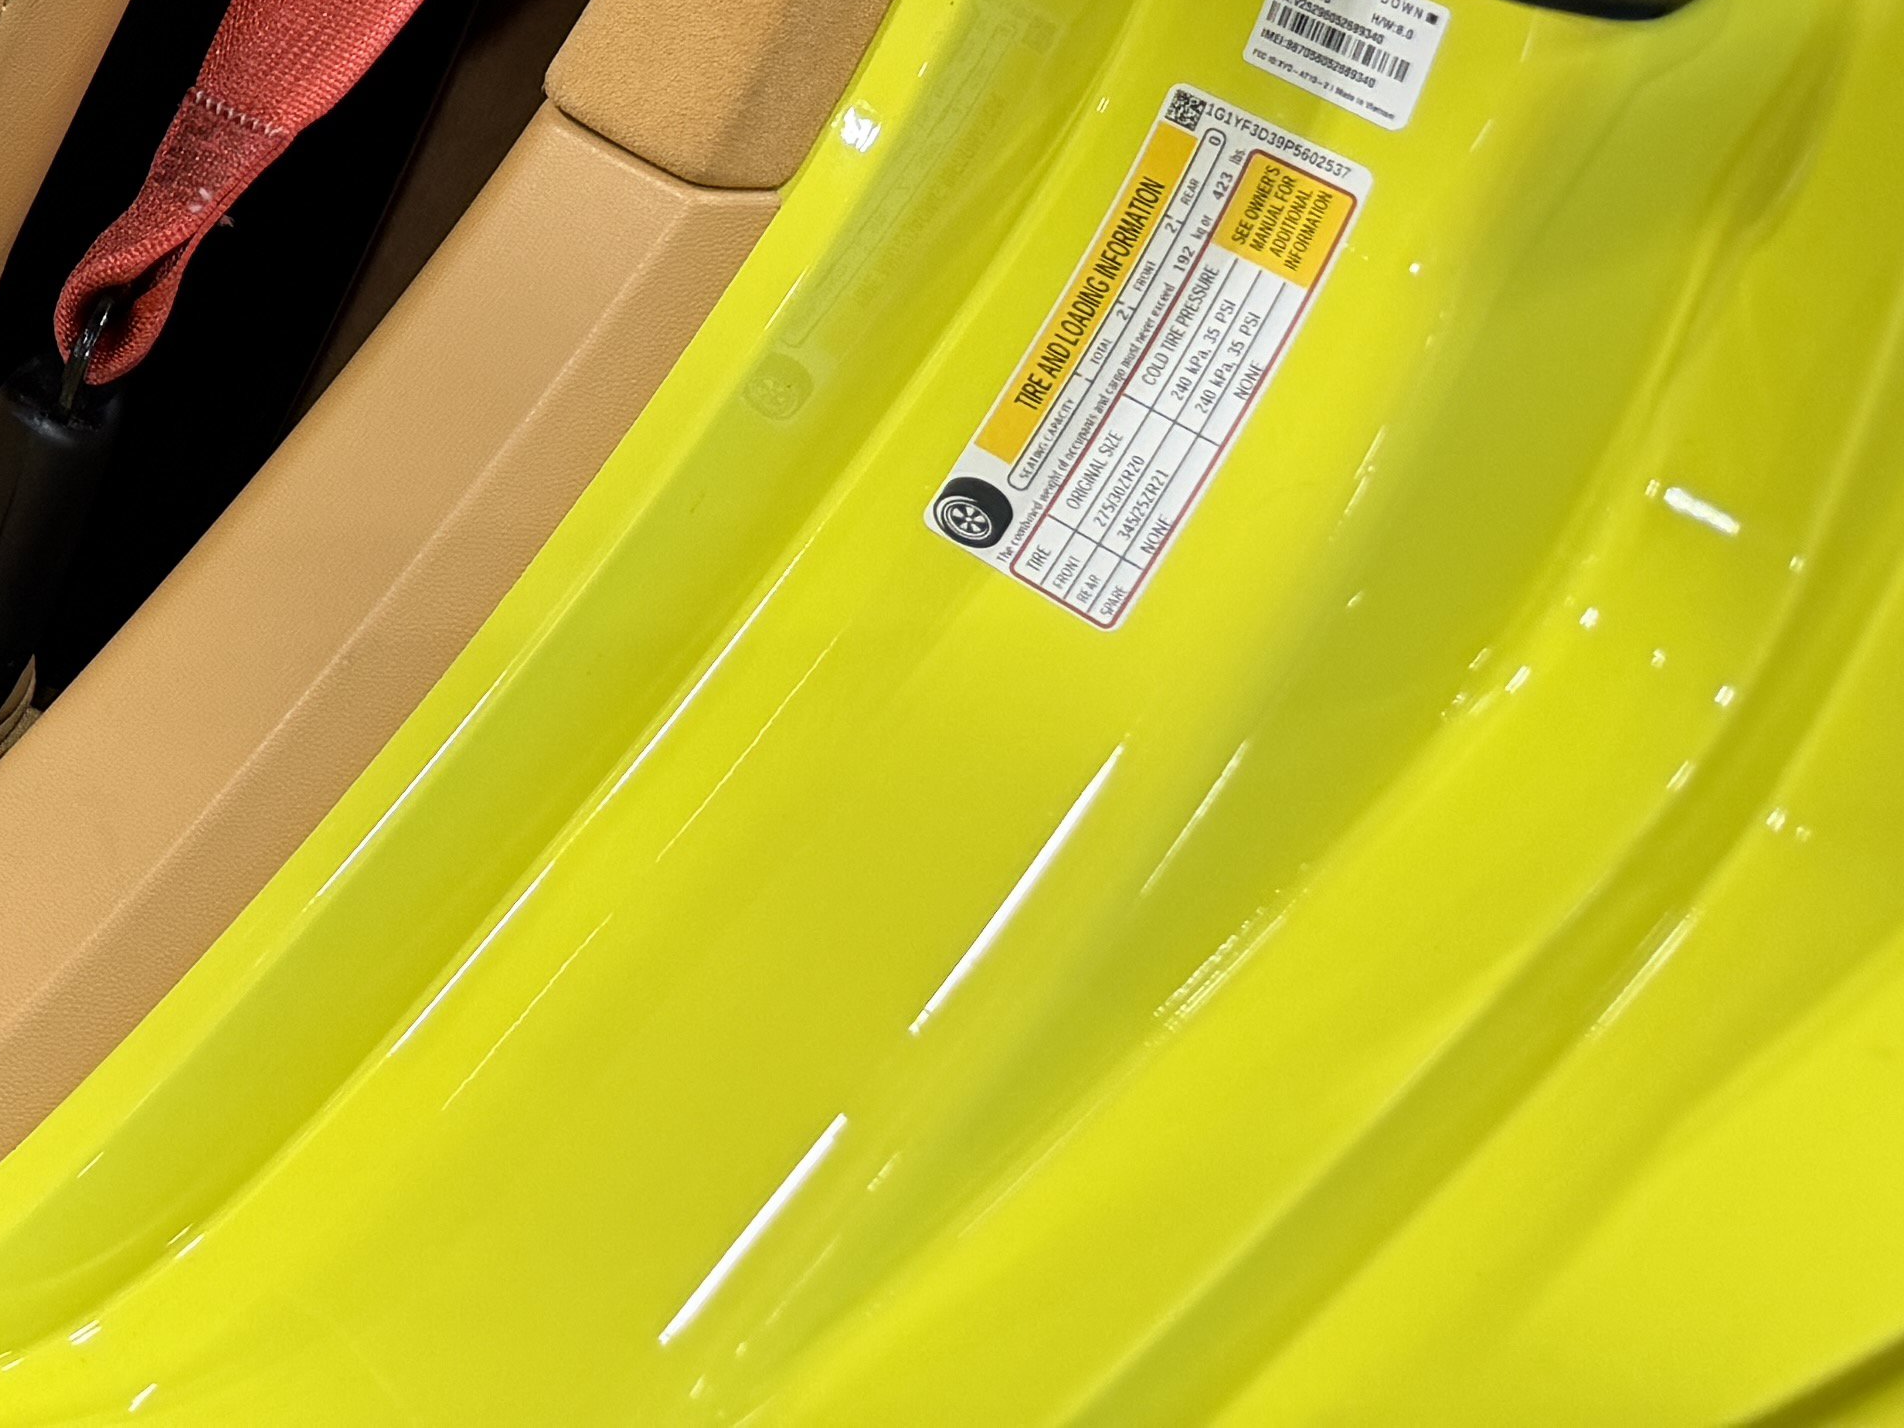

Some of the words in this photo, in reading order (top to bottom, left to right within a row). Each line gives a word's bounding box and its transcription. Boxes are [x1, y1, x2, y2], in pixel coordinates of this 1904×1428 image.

[1203, 101, 1353, 180] 1G1YF3D39P5602537
[1178, 177, 1202, 205] REAR
[1208, 170, 1235, 201] 423
[1239, 163, 1285, 222] OWNER'S
[1090, 175, 1167, 280] INFORMATION
[1189, 224, 1211, 242] kg
[1198, 213, 1212, 227] or
[1229, 218, 1255, 246] SEE
[1245, 200, 1286, 252] MANUAL
[1271, 174, 1299, 203] FOR
[1264, 186, 1317, 258] ADDITIONAL
[1278, 189, 1338, 271] INFORMATION
[1131, 259, 1157, 292] FRONT
[1163, 221, 1178, 234] 2
[1171, 244, 1197, 273] 192
[1053, 273, 1111, 347] LOADING
[1139, 350, 1171, 387] COLD
[1159, 323, 1186, 353] TIRE
[1173, 263, 1221, 328] PRESSURE
[1034, 339, 1073, 379] AND
[1089, 336, 1112, 365] TOTAL
[1114, 307, 1130, 321] 2
[1169, 374, 1193, 401] 240
[1201, 325, 1221, 345] 35
[1213, 298, 1237, 324] PSI
[1193, 387, 1218, 414] 240
[1226, 337, 1246, 358] 35
[1237, 310, 1262, 337] PSI
[1231, 358, 1265, 401] NONE
[1013, 371, 1053, 413] TIRE
[1090, 393, 1110, 414] and
[1041, 395, 1076, 443] CAPACITY
[1064, 454, 1108, 512] ORIGINAL
[1097, 428, 1124, 458] SIZE
[1091, 451, 1146, 529] 275/30ZR20
[1115, 466, 1169, 543] 345/25ZR21
[996, 543, 1015, 564] The
[1138, 511, 1174, 556] NONE
[1025, 543, 1052, 573] TIRE
[1051, 553, 1082, 591] FRONT
[1074, 572, 1101, 604] REAR
[1098, 582, 1128, 619] SPARE
